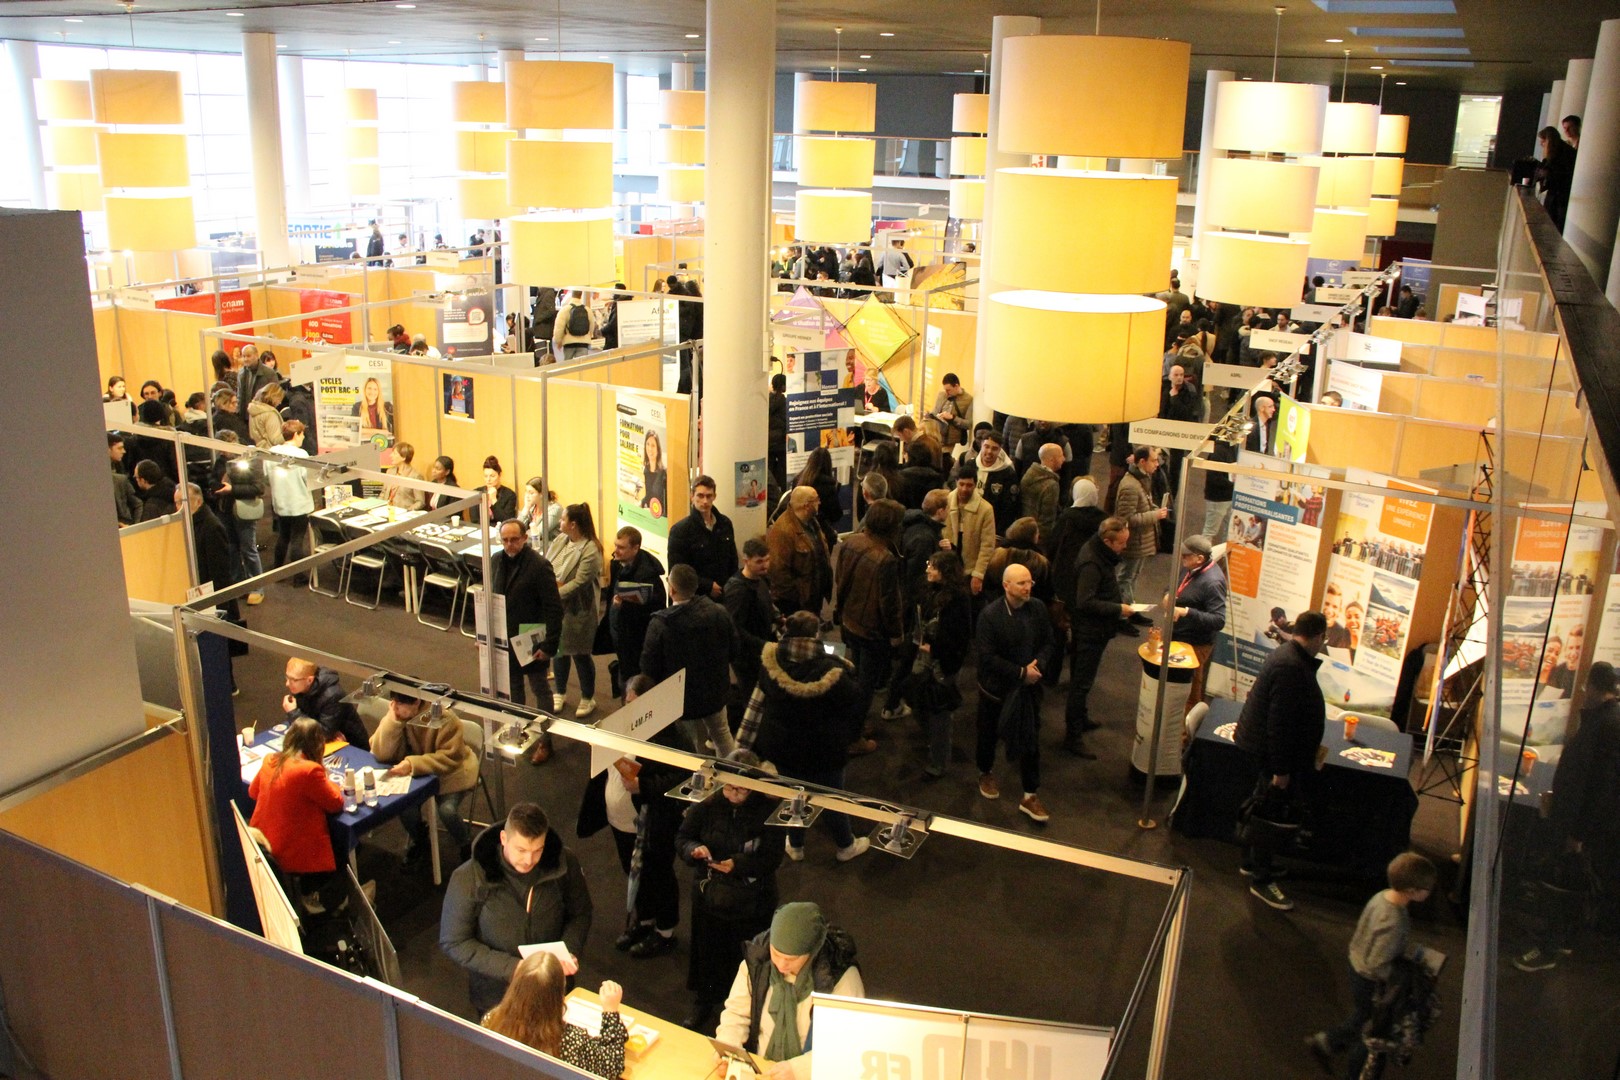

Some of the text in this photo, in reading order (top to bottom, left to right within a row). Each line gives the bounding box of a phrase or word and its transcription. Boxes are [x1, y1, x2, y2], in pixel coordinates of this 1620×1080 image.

[222, 299, 244, 308] cnam
[1144, 428, 1180, 438] COMPAGNONS
[1236, 494, 1267, 508] FORMATIONS
[1234, 502, 1294, 522] PROFESSIONNALISANTES
[631, 710, 652, 731] L4M.FR
